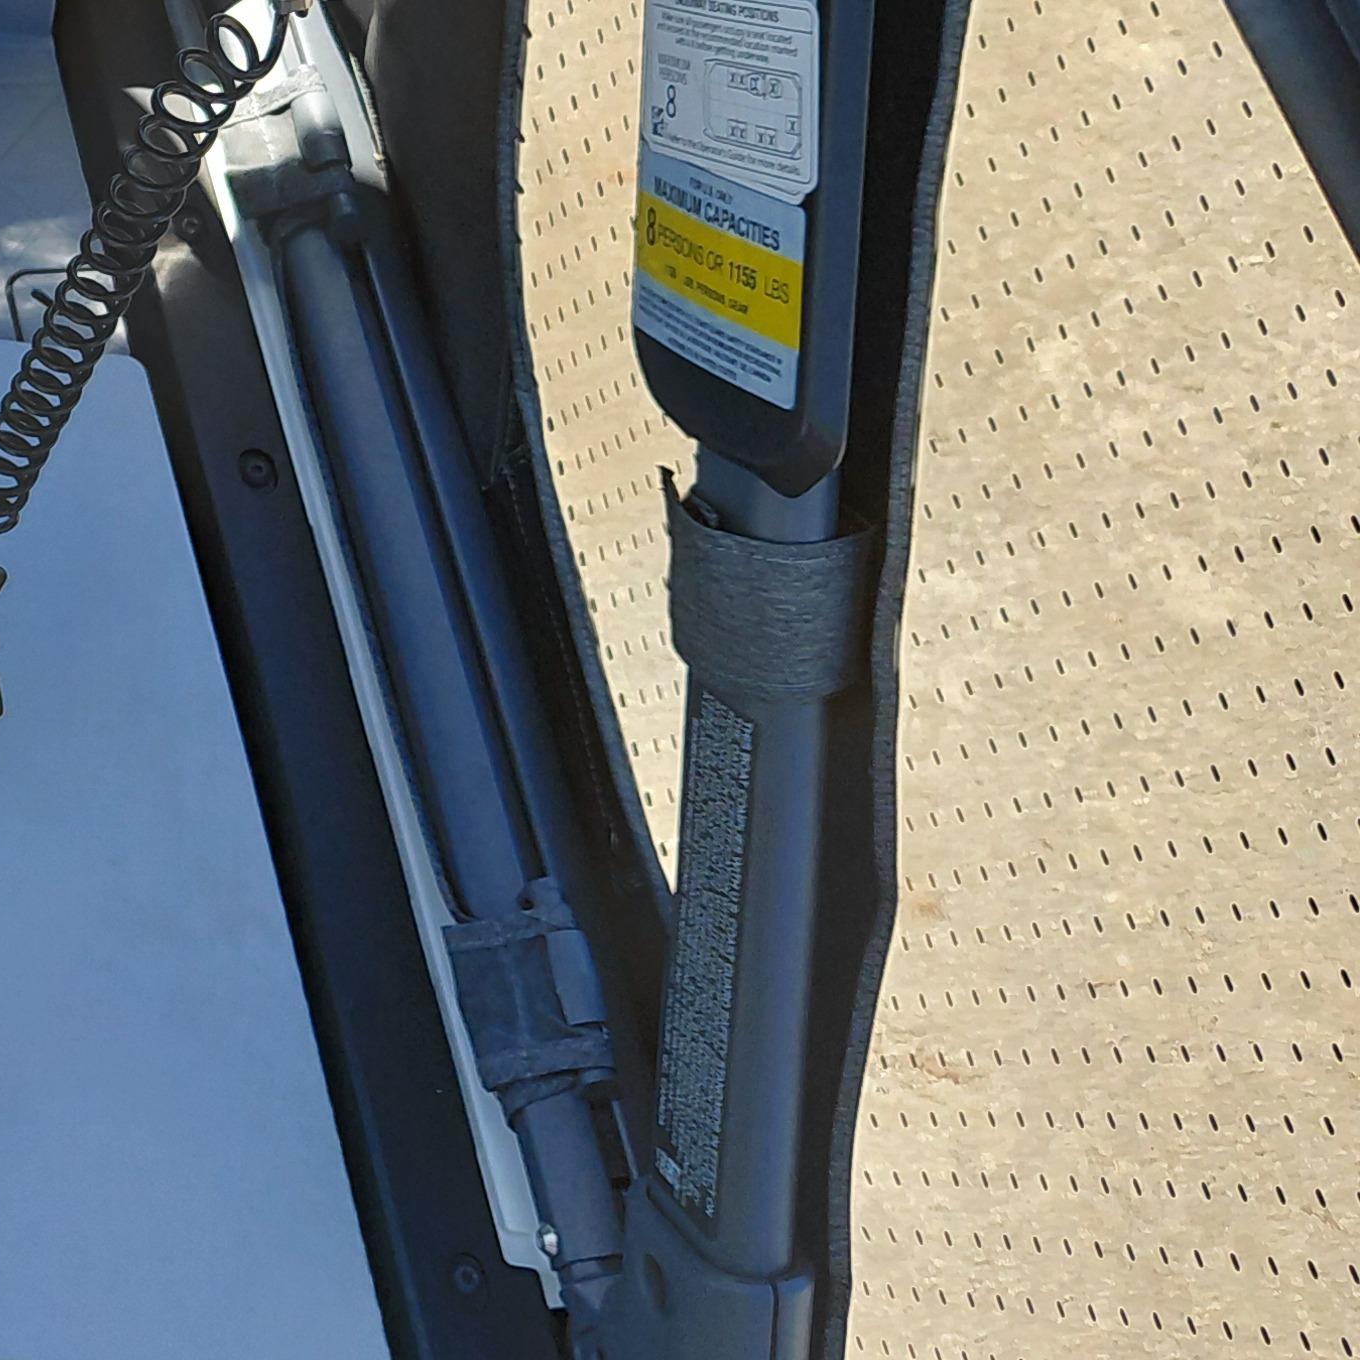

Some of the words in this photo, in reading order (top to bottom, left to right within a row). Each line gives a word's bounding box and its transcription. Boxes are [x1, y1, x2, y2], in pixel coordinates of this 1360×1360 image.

[666, 84, 677, 118] 8
[654, 176, 702, 218] MAXIMUM
[704, 202, 780, 251] CAPACITIES
[646, 206, 657, 246] 8
[658, 223, 704, 266] PERSONS
[706, 250, 724, 272] OR
[728, 261, 758, 291] 1155
[764, 275, 790, 304] LBS
